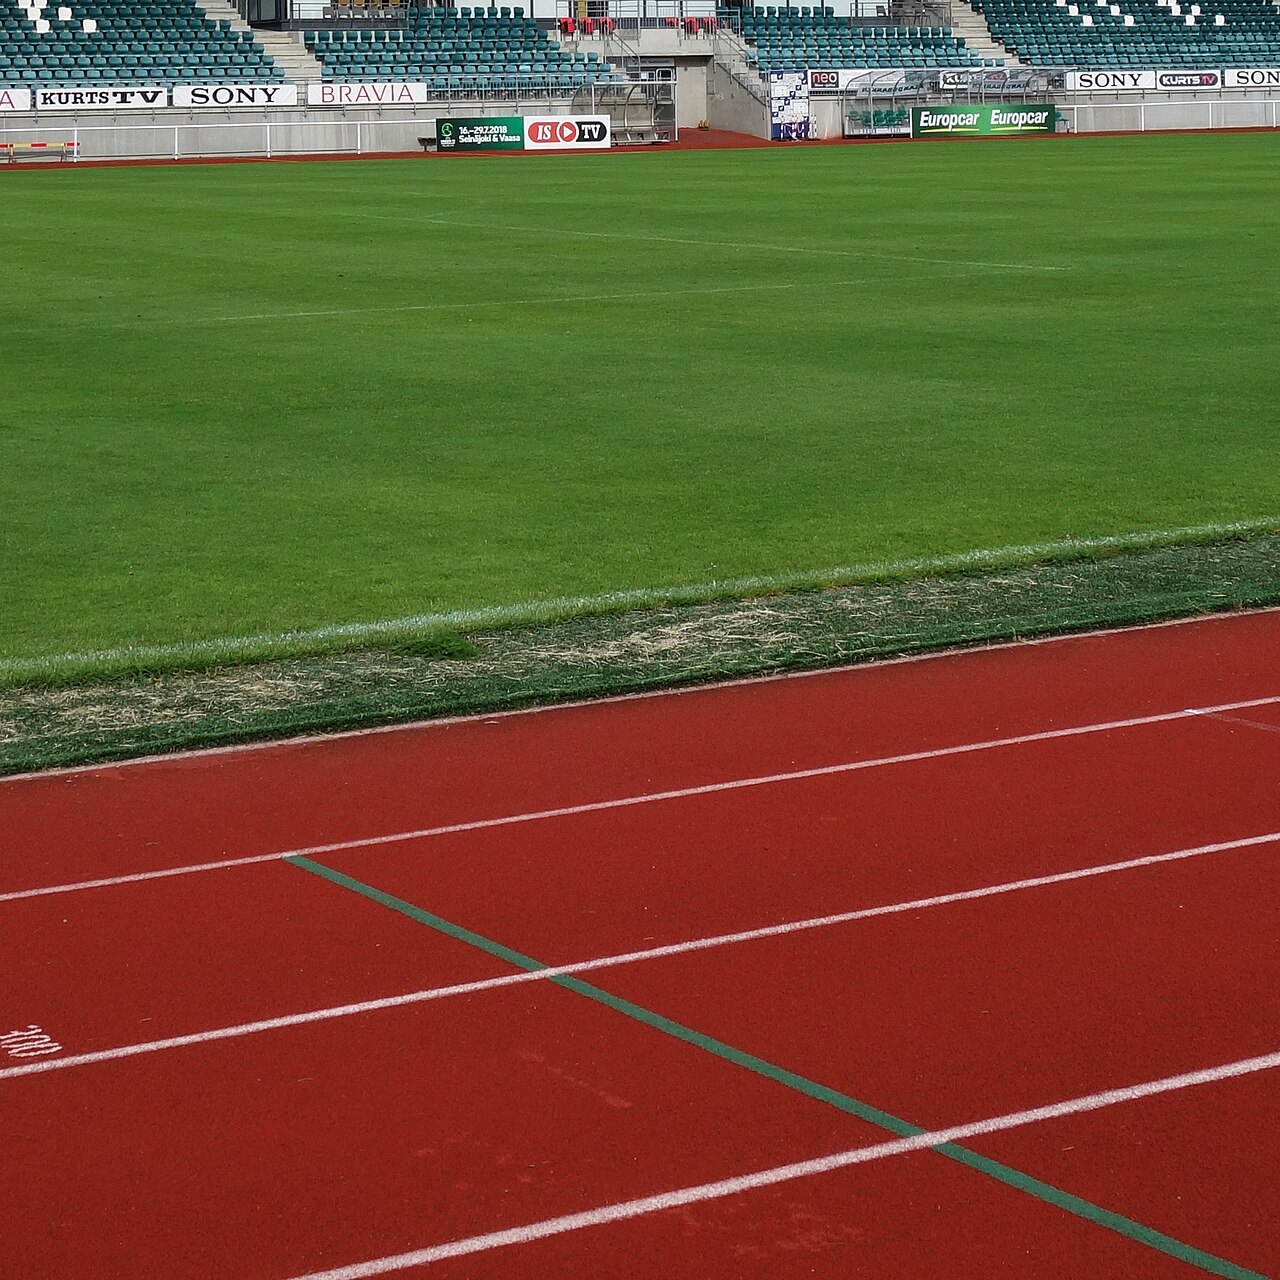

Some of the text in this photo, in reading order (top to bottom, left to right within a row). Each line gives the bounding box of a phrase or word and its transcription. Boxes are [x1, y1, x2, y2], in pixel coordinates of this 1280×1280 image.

[812, 72, 838, 83] neo
[1079, 73, 1143, 88] SONY
[1162, 74, 1216, 86] KURTS TV
[41, 90, 164, 105] KURTS TV
[191, 87, 281, 104] SONY
[322, 84, 414, 103] BRAVIA
[920, 110, 980, 131] Europcar
[990, 109, 1049, 130] Europcar
[499, 133, 520, 142] Vaasa
[537, 124, 601, 140] IS TV
